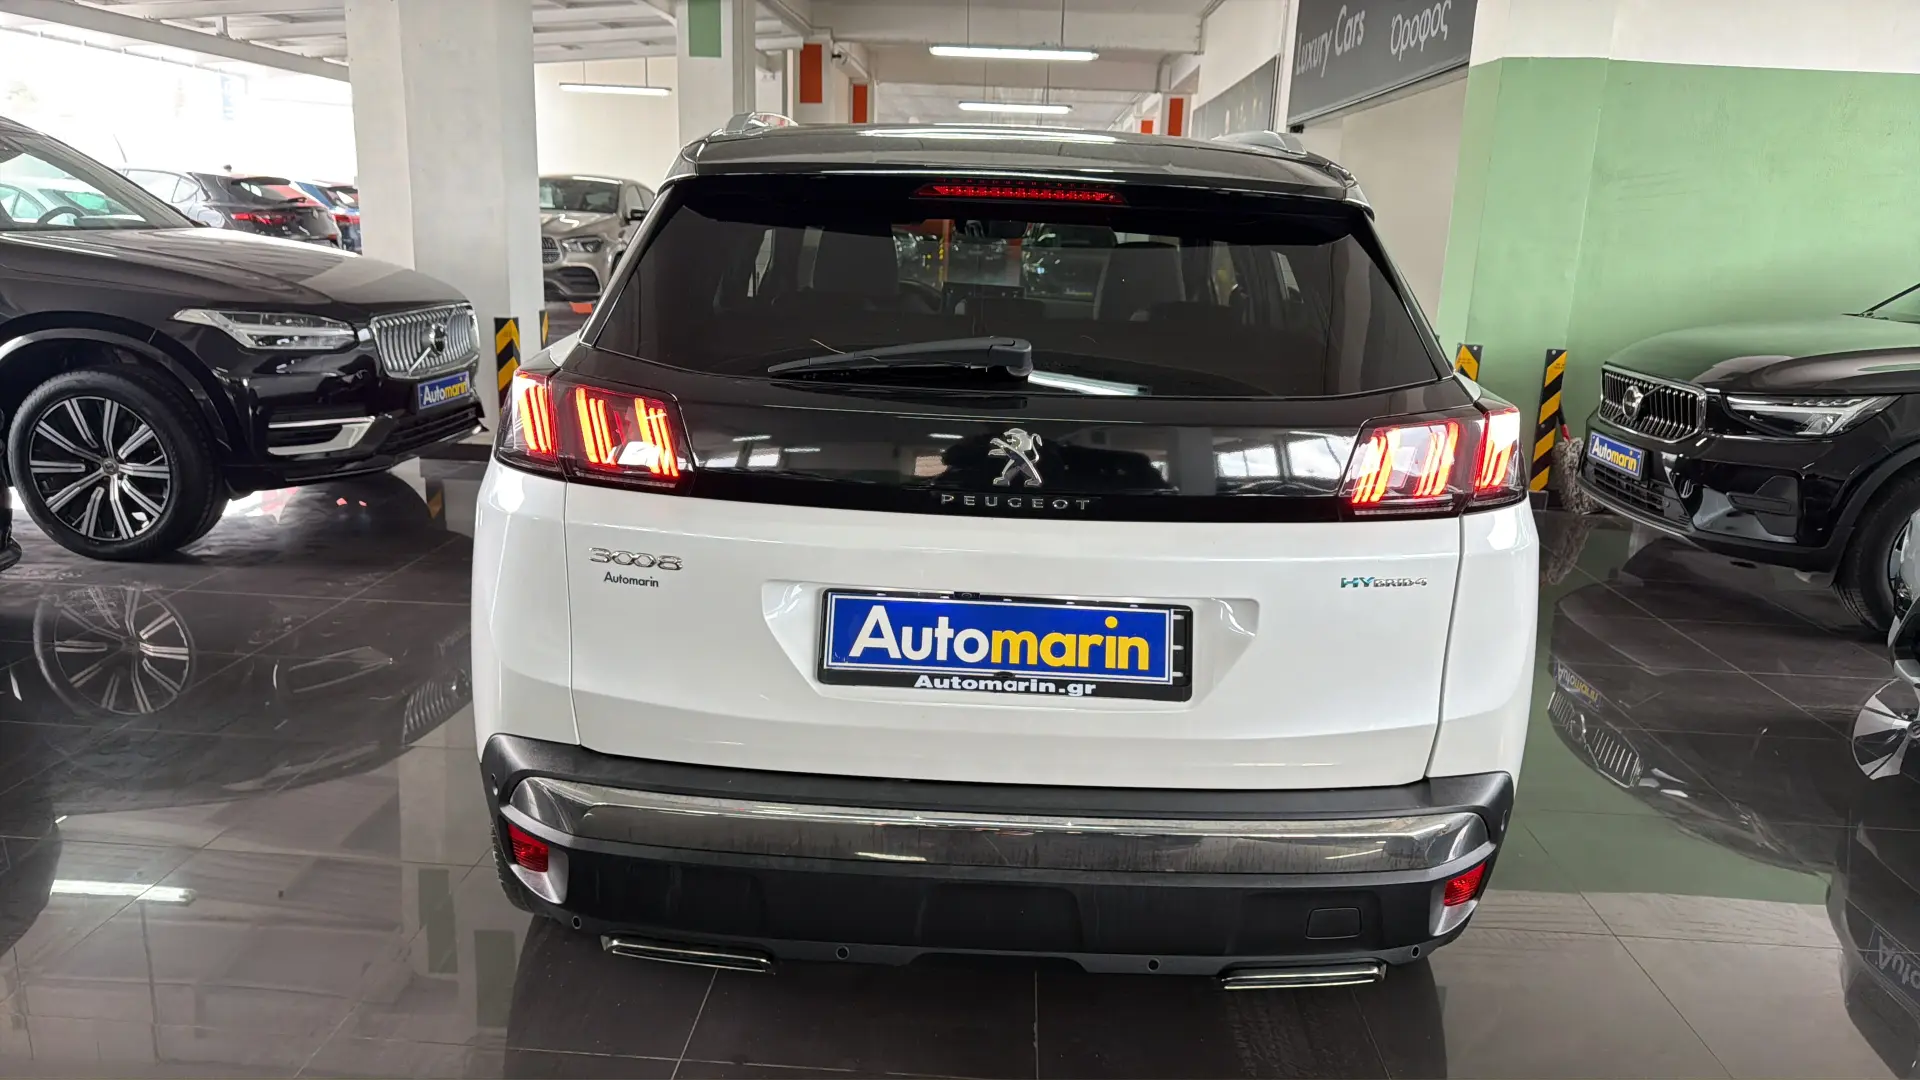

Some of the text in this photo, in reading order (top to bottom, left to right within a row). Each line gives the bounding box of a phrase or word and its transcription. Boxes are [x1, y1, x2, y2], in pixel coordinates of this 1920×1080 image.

[1296, 4, 1366, 78] Luxury Cars
[422, 376, 468, 405] Automarin
[1591, 437, 1637, 471] Automarin
[941, 494, 1090, 510] PEUGEOT
[588, 547, 683, 571] 3008
[604, 571, 659, 588] Automarin
[1340, 577, 1427, 588] HYBRID4
[848, 604, 1149, 671] Automarin
[914, 674, 1097, 697] Automarin.gr
